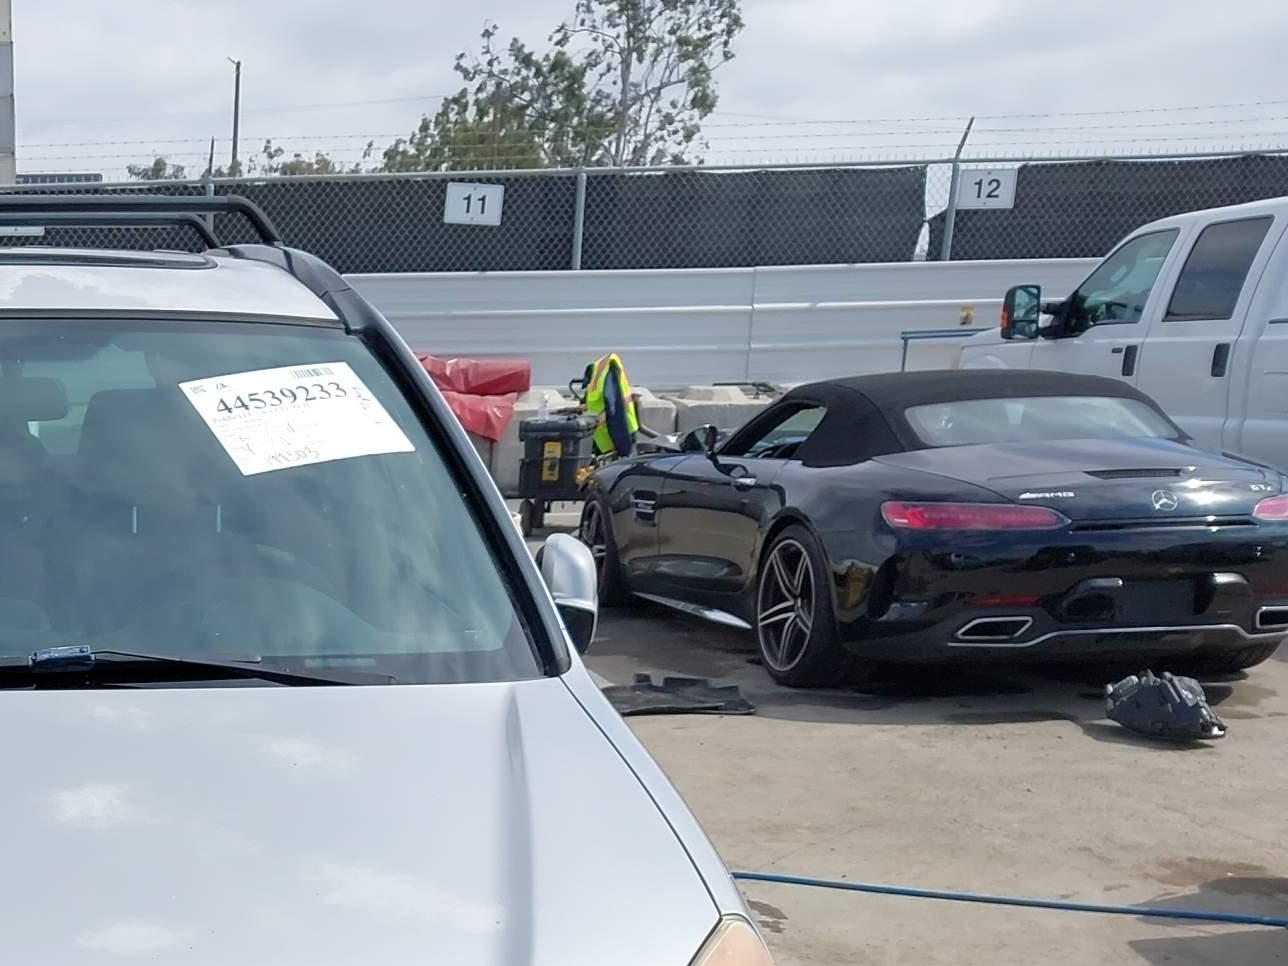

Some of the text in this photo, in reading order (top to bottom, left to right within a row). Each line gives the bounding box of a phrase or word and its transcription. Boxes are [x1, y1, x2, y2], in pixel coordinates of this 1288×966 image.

[974, 178, 1001, 199] 12
[463, 193, 486, 215] 11
[216, 381, 348, 415] 44539233
